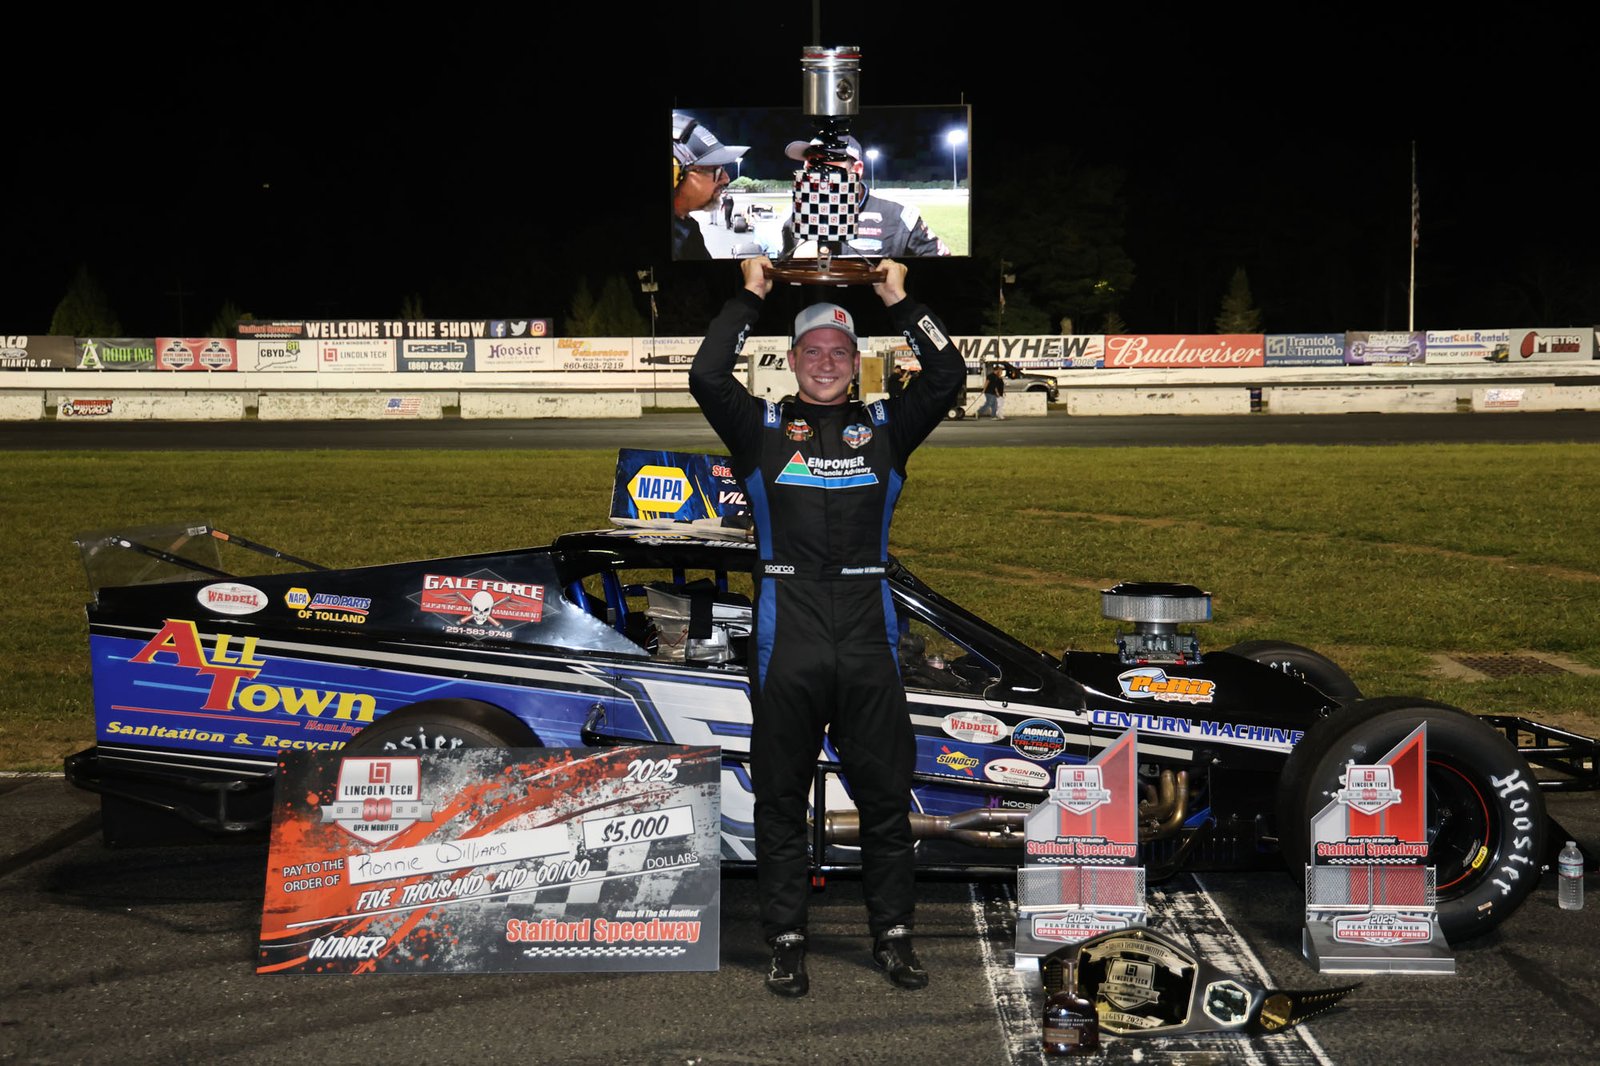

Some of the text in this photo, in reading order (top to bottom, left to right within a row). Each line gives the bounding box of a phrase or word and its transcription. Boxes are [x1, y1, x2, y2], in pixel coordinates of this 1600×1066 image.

[306, 321, 485, 338] WELCOME TO THE SHOW
[957, 337, 1090, 358] MAYHEW
[1287, 336, 1335, 346] Trantolo
[102, 348, 154, 362] ROOFING
[260, 349, 285, 358] CBYD
[340, 351, 368, 359] LINCOLN
[488, 343, 541, 358] Hoosier
[1107, 336, 1263, 366] Budweiser
[1296, 346, 1343, 356] Trantolo
[2, 359, 51, 368] NIANTIC, CT
[807, 456, 865, 470] EMPOWER
[712, 465, 733, 478] Sta
[813, 466, 872, 476] Financial Advisory
[638, 477, 682, 501] NAPA
[718, 491, 748, 505] VIL
[764, 565, 795, 574] sparco
[424, 575, 544, 600] GALE FORCE
[207, 590, 259, 607] WADDELL
[288, 592, 372, 609] NAPA AUTO PARTS
[297, 611, 366, 624] OF TOLLAND
[491, 608, 541, 619] MANAGEMENT
[445, 625, 513, 639] 251-583-9748
[106, 720, 225, 743] Sanitation
[234, 733, 254, 746] &
[950, 718, 999, 736] WADDELL
[1022, 727, 1059, 737] MONACO
[1092, 709, 1305, 745] CENTURN MACHINE
[1013, 733, 1064, 744] MODIFIED
[1013, 739, 1063, 750] TRI-TRACK
[937, 755, 979, 767] SUNOCO
[622, 758, 682, 783] 2025
[1009, 767, 1029, 775] SIGN
[1029, 770, 1047, 778] PRO
[344, 785, 413, 796] LINCOLN TECH
[362, 797, 392, 822] 80
[1002, 800, 1040, 809] HOOSI
[353, 824, 399, 832] OPEN MODIFIED
[601, 815, 670, 843] $5,000
[1489, 769, 1534, 895] Hoosier
[1027, 841, 1137, 857] Stafford Speedway
[1317, 843, 1429, 857] Stafford Speedway
[282, 858, 344, 877] PAY TO THE
[358, 854, 424, 878] Ronnie
[283, 874, 341, 893] ORDER OF
[356, 852, 699, 911] FIVE THOUSAND AND 00/100 DOLLARS
[616, 910, 633, 918] Home
[645, 910, 657, 918] The
[668, 910, 699, 918] Modified
[1067, 913, 1093, 923] 2025
[1369, 914, 1396, 924] 2025
[506, 917, 701, 943] Stafford Speedway
[1037, 928, 1056, 936] OPEN
[308, 936, 387, 959] WINNER
[1112, 974, 1132, 984] LINCOLN
[1126, 1016, 1144, 1026] 2025
